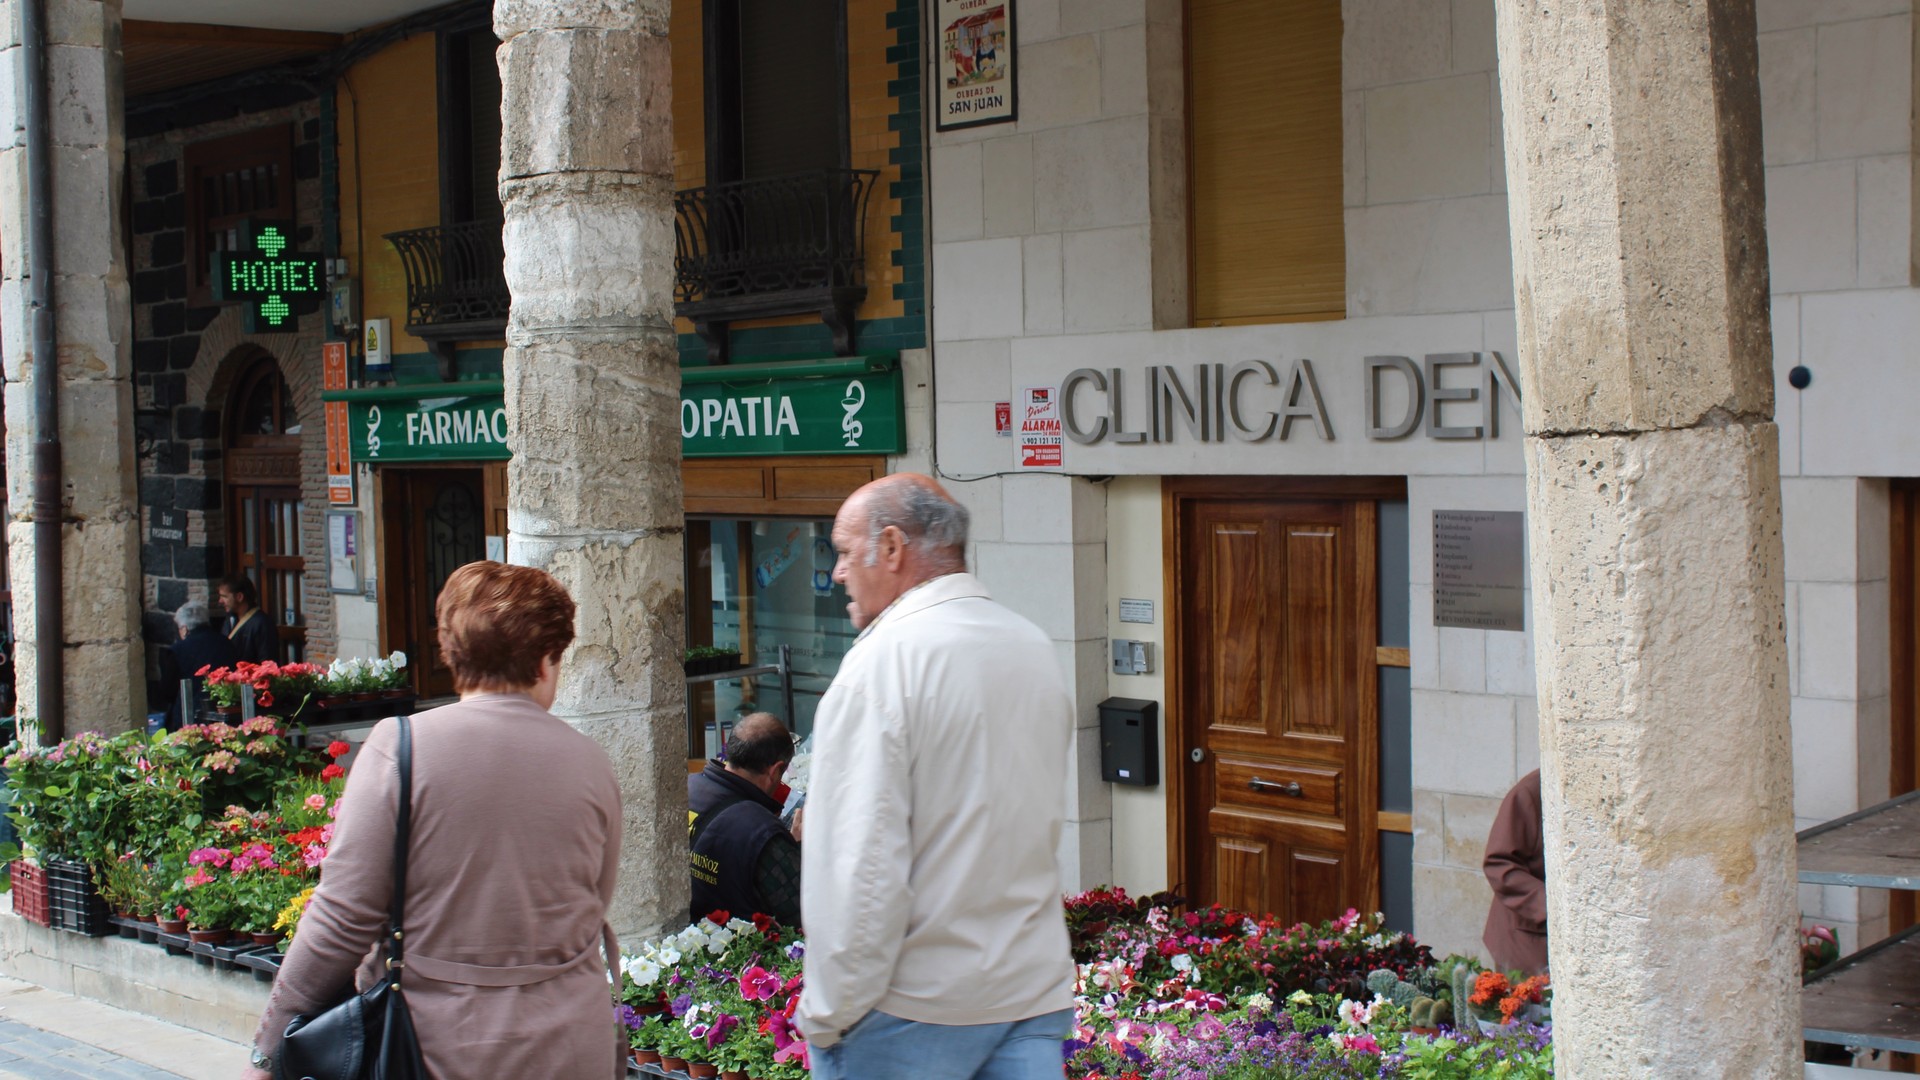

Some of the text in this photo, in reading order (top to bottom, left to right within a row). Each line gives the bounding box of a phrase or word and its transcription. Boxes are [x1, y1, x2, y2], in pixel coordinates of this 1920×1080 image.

[956, 85, 995, 99] OLBEAS DE
[949, 101, 970, 114] SAN
[1058, 359, 1335, 445] CLINICA
[680, 395, 800, 439] OPATIA
[1022, 420, 1061, 431] ALARMA
